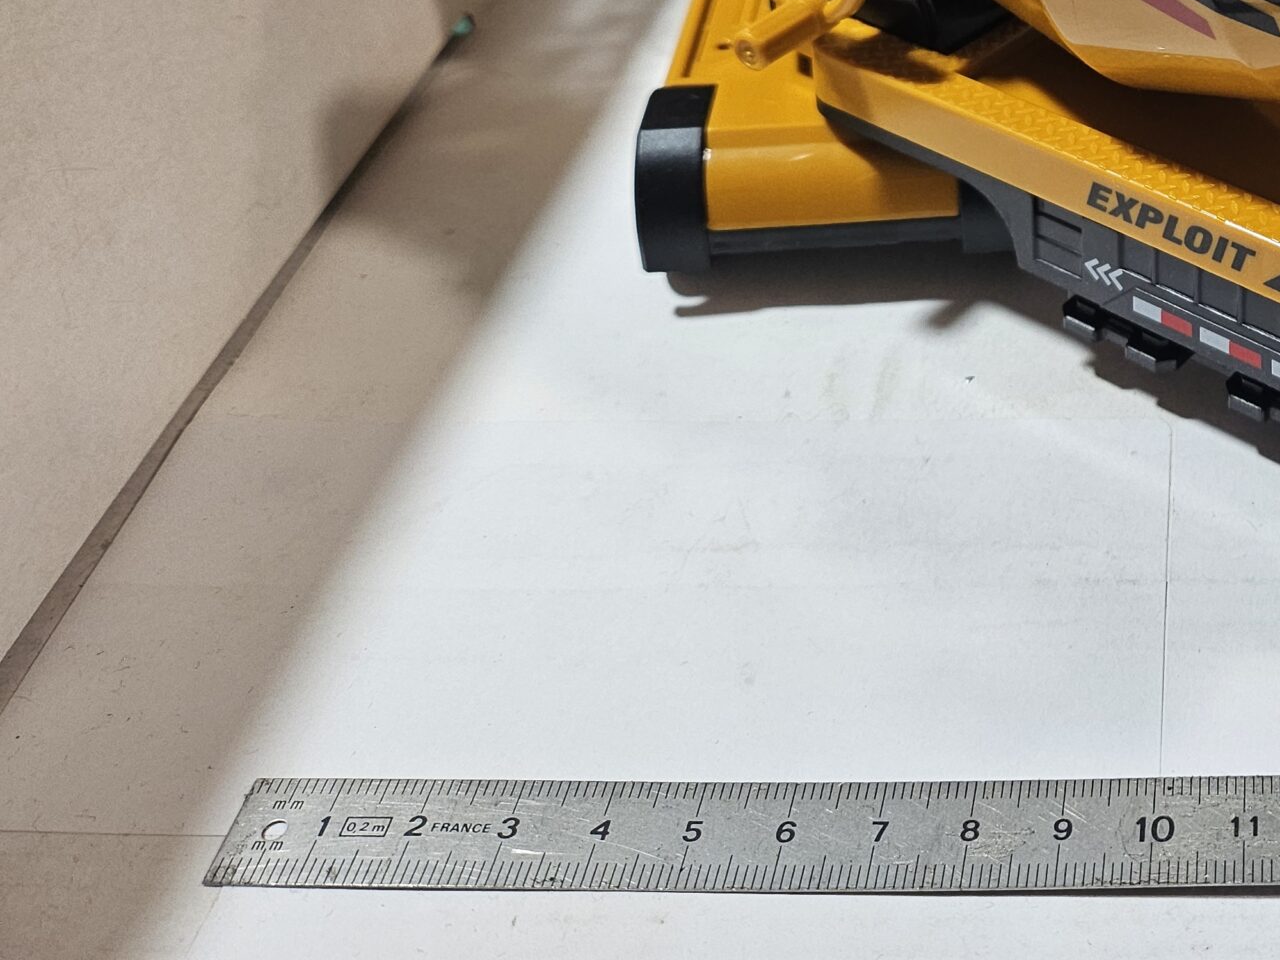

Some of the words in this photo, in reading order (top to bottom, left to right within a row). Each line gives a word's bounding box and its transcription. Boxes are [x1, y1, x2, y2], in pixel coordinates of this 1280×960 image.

[1086, 181, 1257, 272] EXPLOIT
[317, 815, 332, 837] 1
[403, 815, 428, 837] 2
[497, 817, 521, 840] 3
[589, 819, 611, 841] 4
[682, 820, 704, 843] 5
[775, 820, 797, 843] 6
[872, 821, 890, 843] 7
[959, 819, 980, 842] 8
[1053, 818, 1073, 841] 9
[1135, 815, 1175, 843] 10
[1230, 815, 1259, 838] 11
[431, 822, 492, 833] FRANCE
